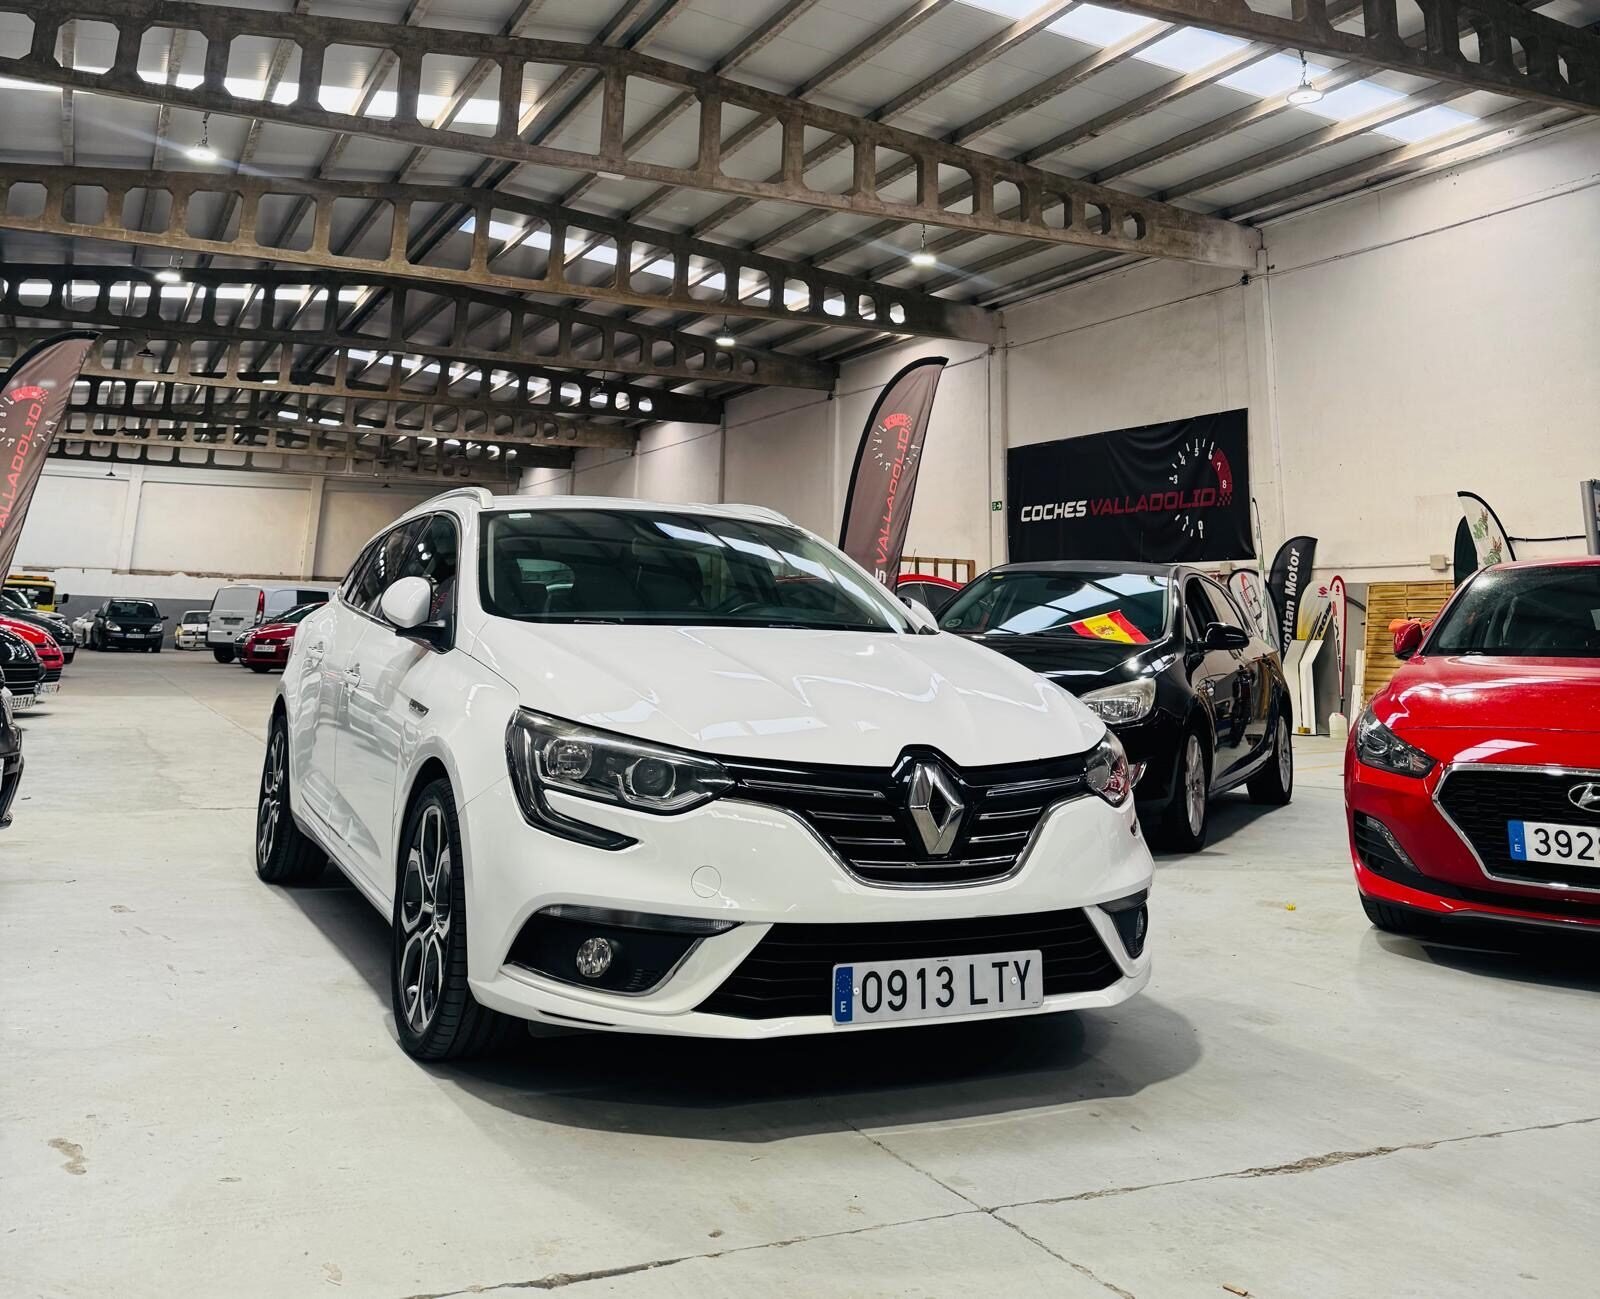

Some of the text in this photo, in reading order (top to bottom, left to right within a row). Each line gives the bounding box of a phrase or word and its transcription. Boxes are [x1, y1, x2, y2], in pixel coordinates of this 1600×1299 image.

[1180, 456, 1186, 465] 4
[1194, 447, 1199, 456] 5
[1208, 451, 1213, 460] 6
[0, 403, 42, 528] ALLADOLID
[1216, 462, 1221, 471] 7
[1173, 474, 1178, 484] 3
[1222, 480, 1227, 489] 8
[876, 427, 909, 564] VALLADOLID
[1020, 488, 1216, 522] COCHES VALLADOLID
[1284, 547, 1301, 596] Motor
[1514, 828, 1600, 860] E 392
[840, 959, 1031, 1013] E 0913 LTY
